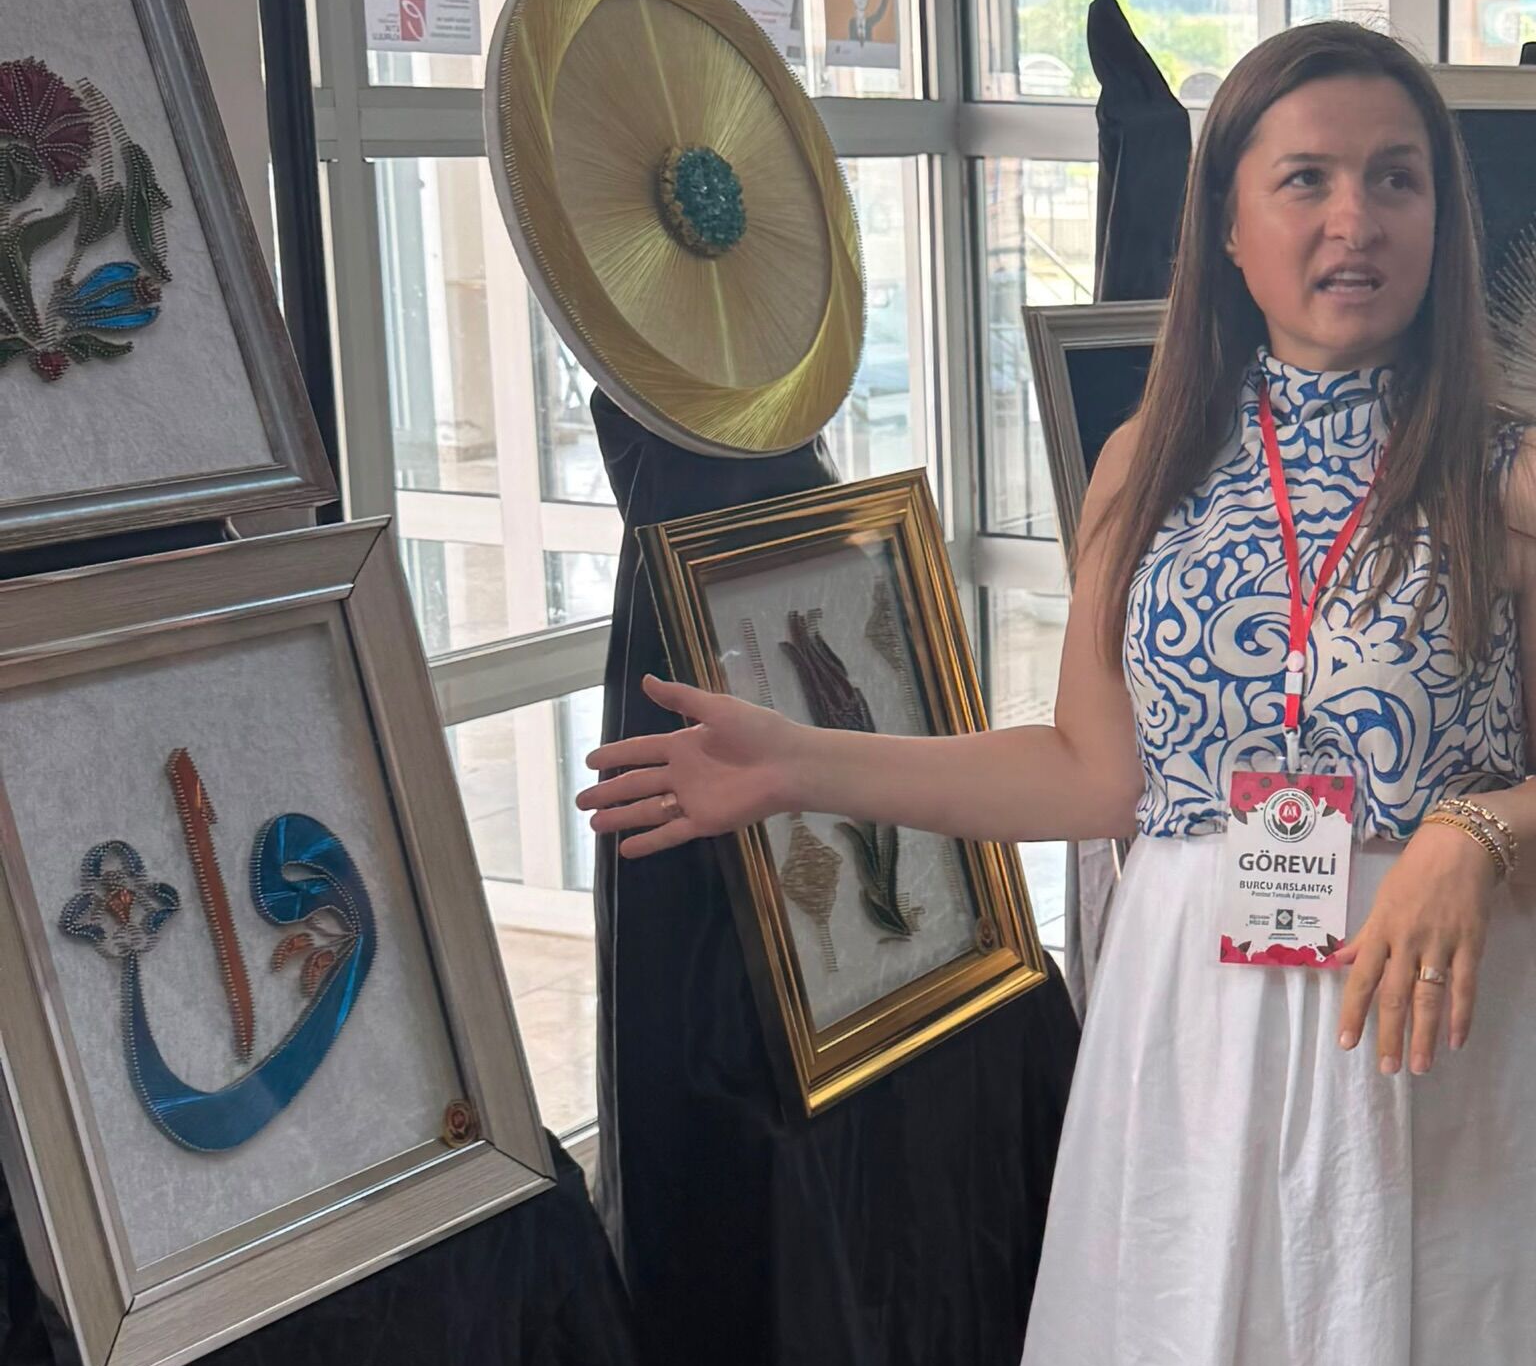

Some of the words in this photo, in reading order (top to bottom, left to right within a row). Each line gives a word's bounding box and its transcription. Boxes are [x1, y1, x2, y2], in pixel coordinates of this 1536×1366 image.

[1238, 849, 1336, 875] GÖREVLİ
[1239, 880, 1273, 890] BURCU
[1275, 882, 1333, 895] ARSLANTAŞ
